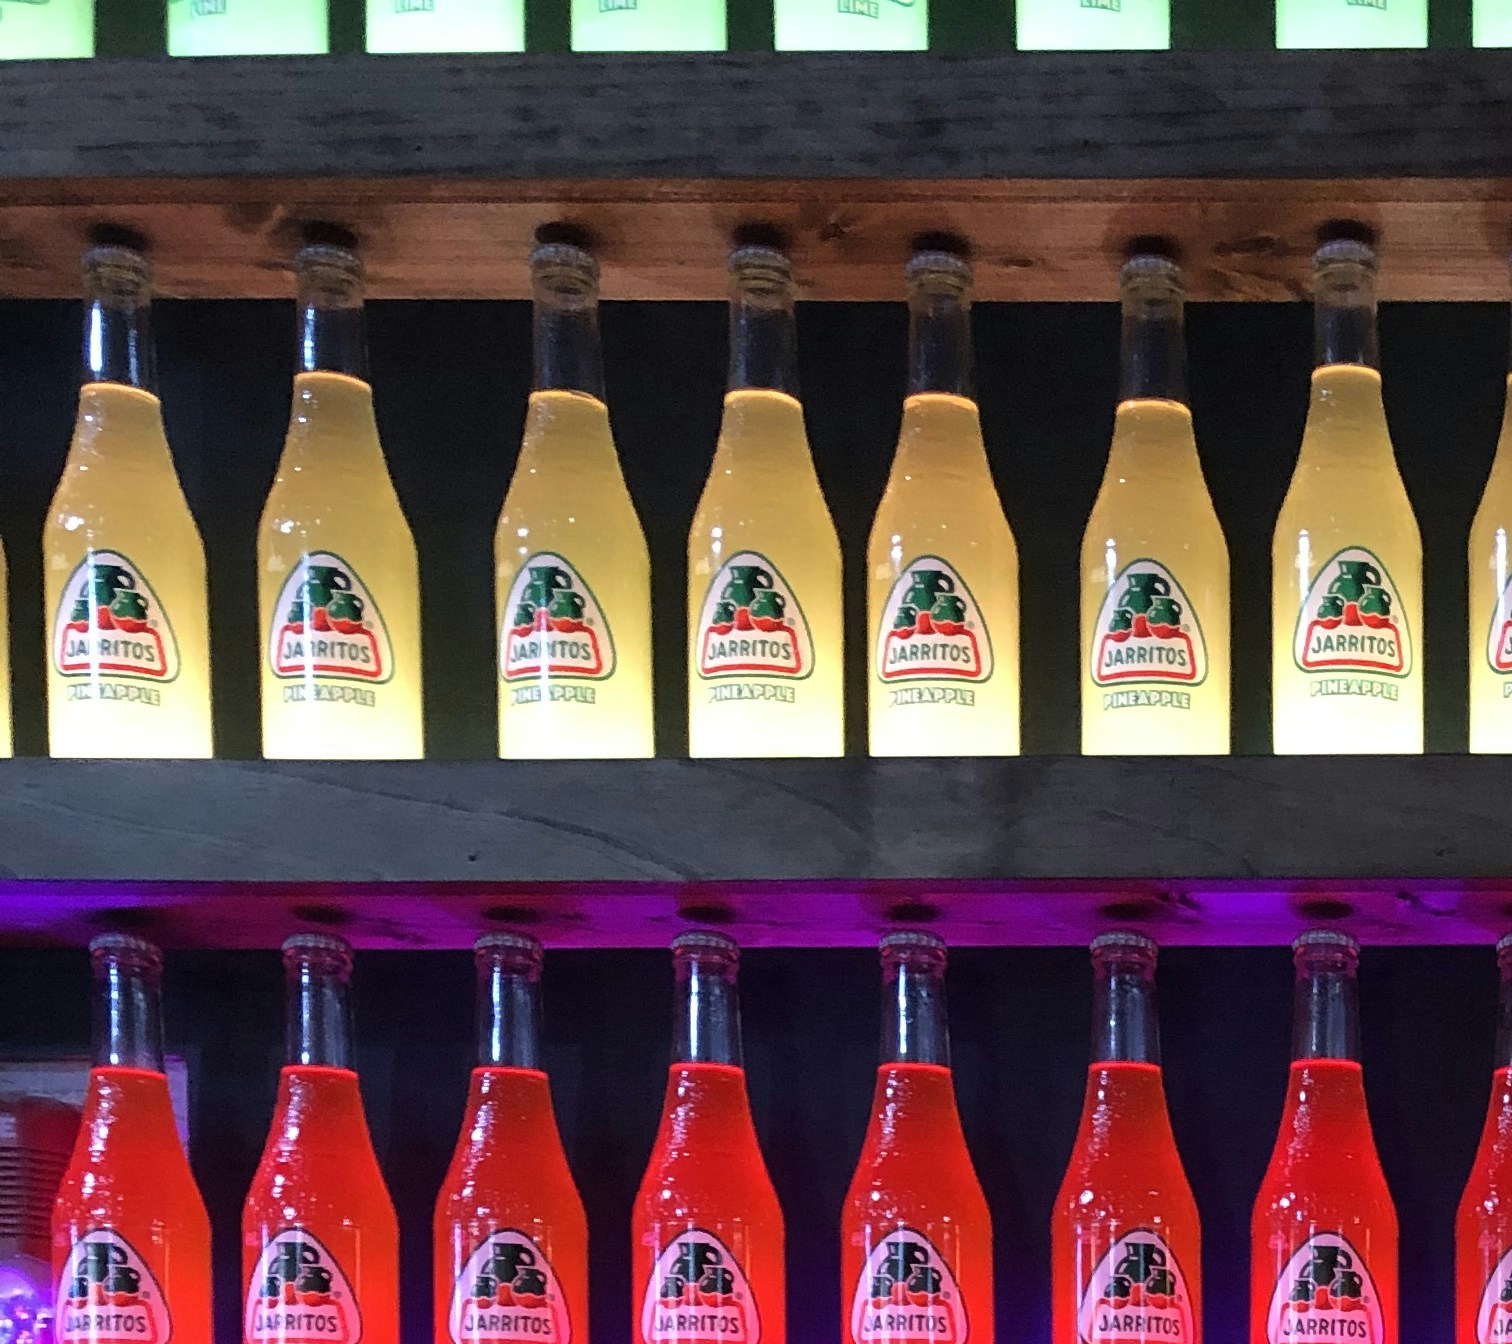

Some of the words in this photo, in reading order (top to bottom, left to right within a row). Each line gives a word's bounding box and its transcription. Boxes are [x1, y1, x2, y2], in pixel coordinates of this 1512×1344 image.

[838, 0, 879, 19] LIME
[708, 638, 791, 662] JARRITOS
[890, 642, 971, 665] JARRITOS
[1104, 644, 1187, 668] JARRITOS
[1311, 634, 1396, 658] JARRITOS
[1103, 690, 1190, 710] PINEAPPLE
[1310, 680, 1398, 701] PINEAPPLE
[1098, 1316, 1180, 1336] JARRITOS
[1283, 1318, 1367, 1339] JARRITOS
